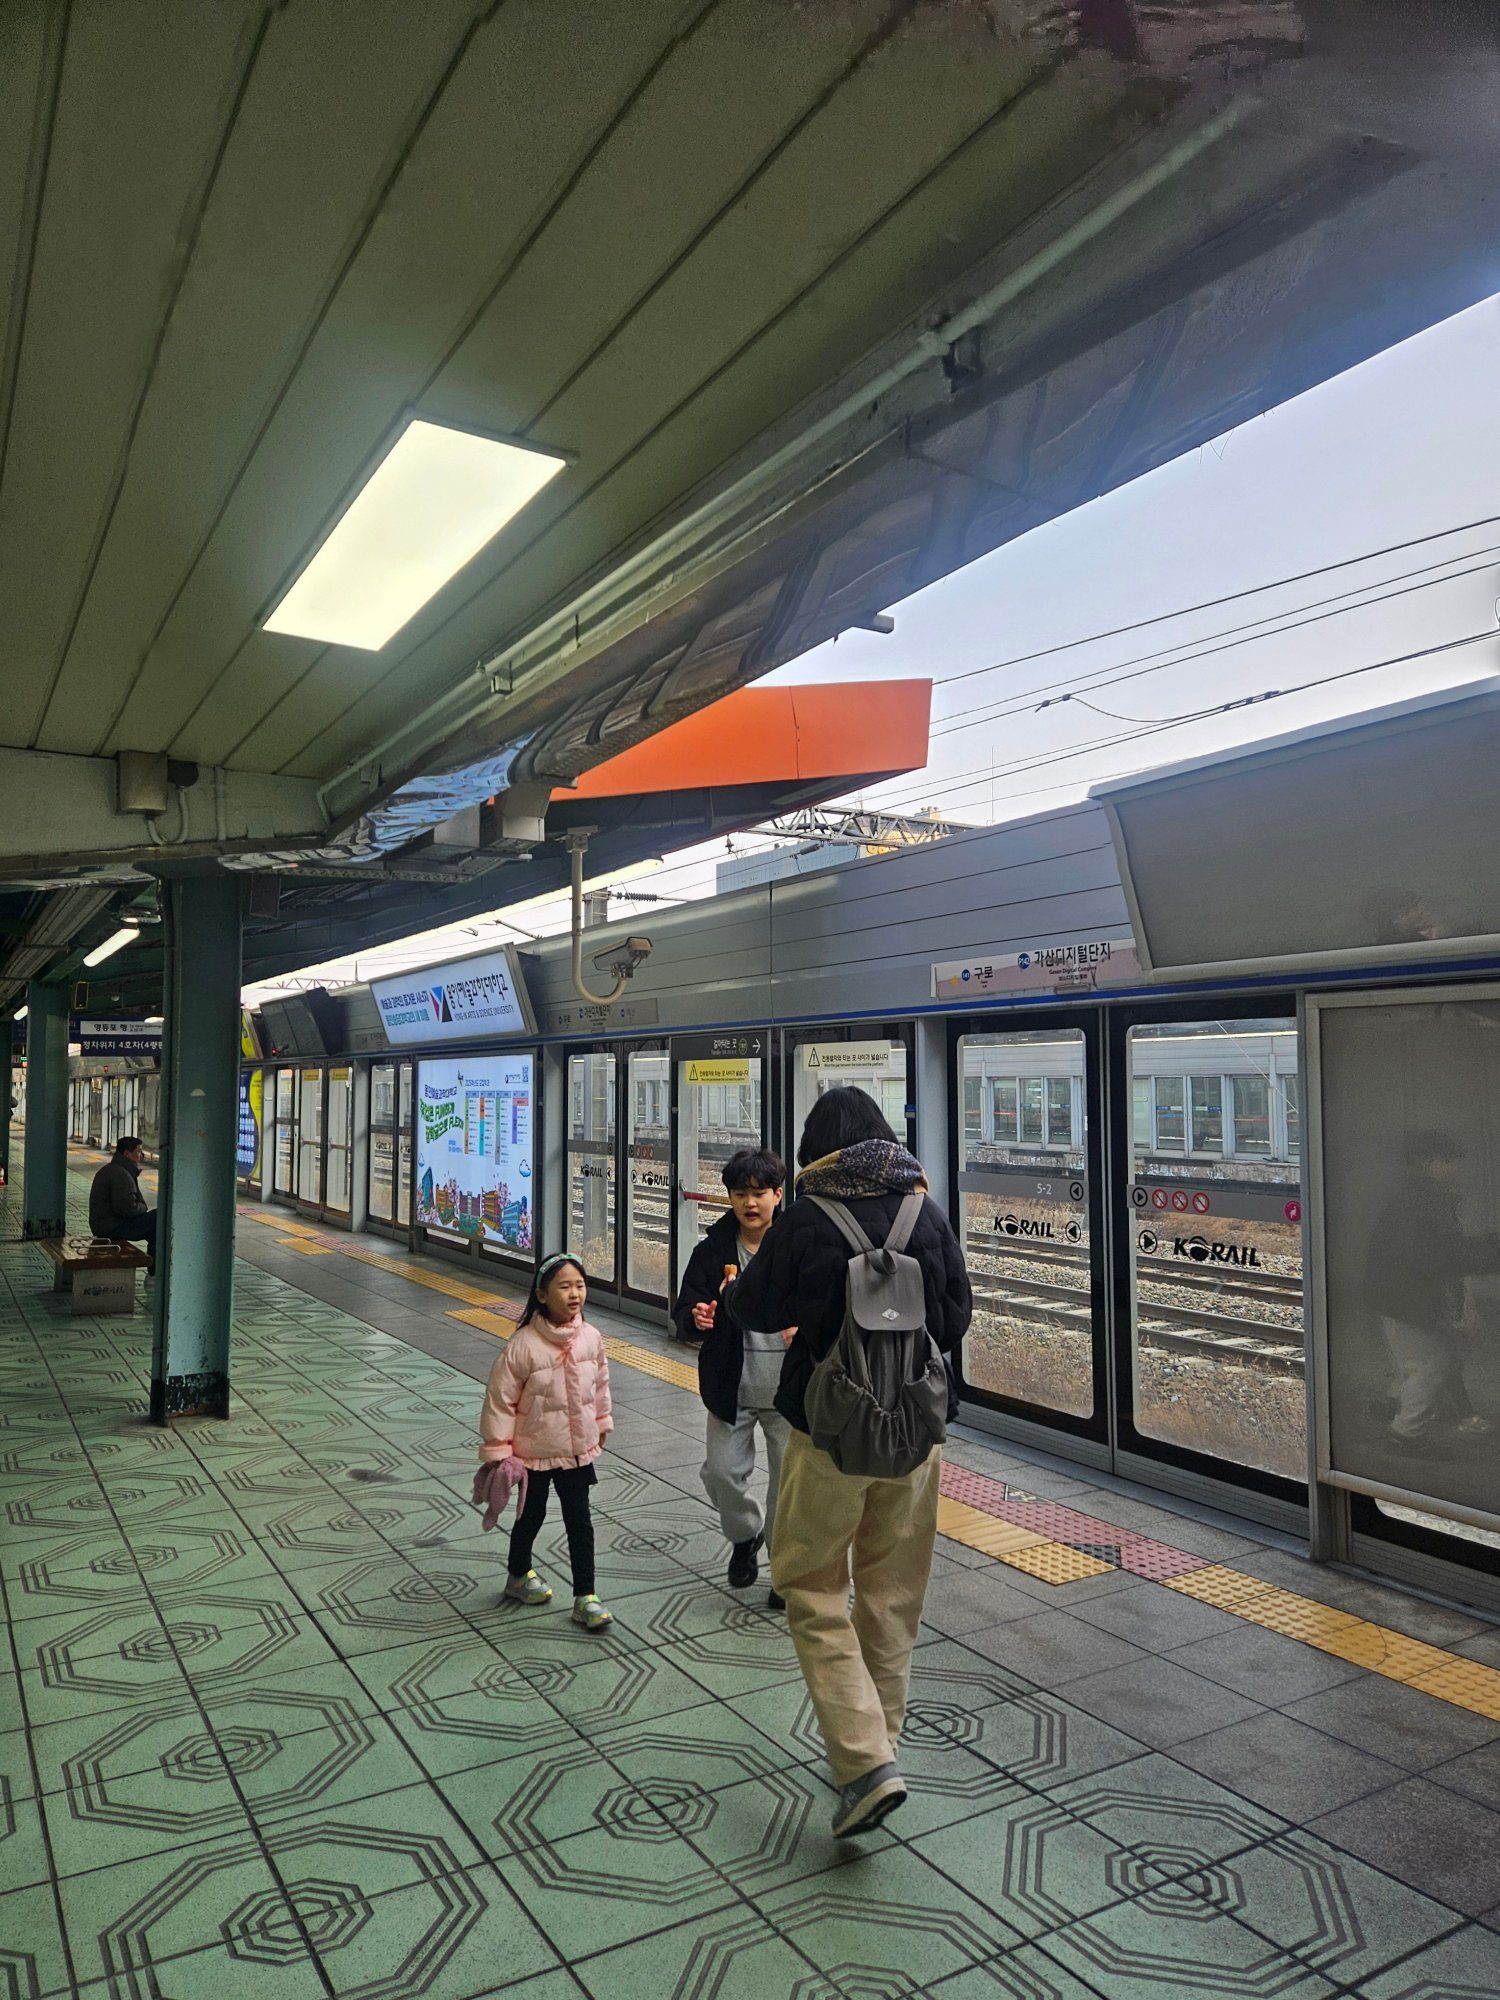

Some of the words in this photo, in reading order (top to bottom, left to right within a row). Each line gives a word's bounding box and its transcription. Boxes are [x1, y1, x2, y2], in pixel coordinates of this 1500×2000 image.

[1034, 942, 1111, 967] 가산디지털단지
[973, 966, 994, 980] 구로
[446, 973, 509, 1010] 용인예술과학대학교
[493, 1004, 515, 1017] UNIVERSITY
[94, 1023, 117, 1032] 영등포
[580, 1164, 603, 1178] KORAIL
[642, 1170, 669, 1187] KORAIL
[1036, 1183, 1052, 1196] 5-2
[993, 1214, 1055, 1239] KORAIL
[1173, 1236, 1262, 1268] KORAIL
